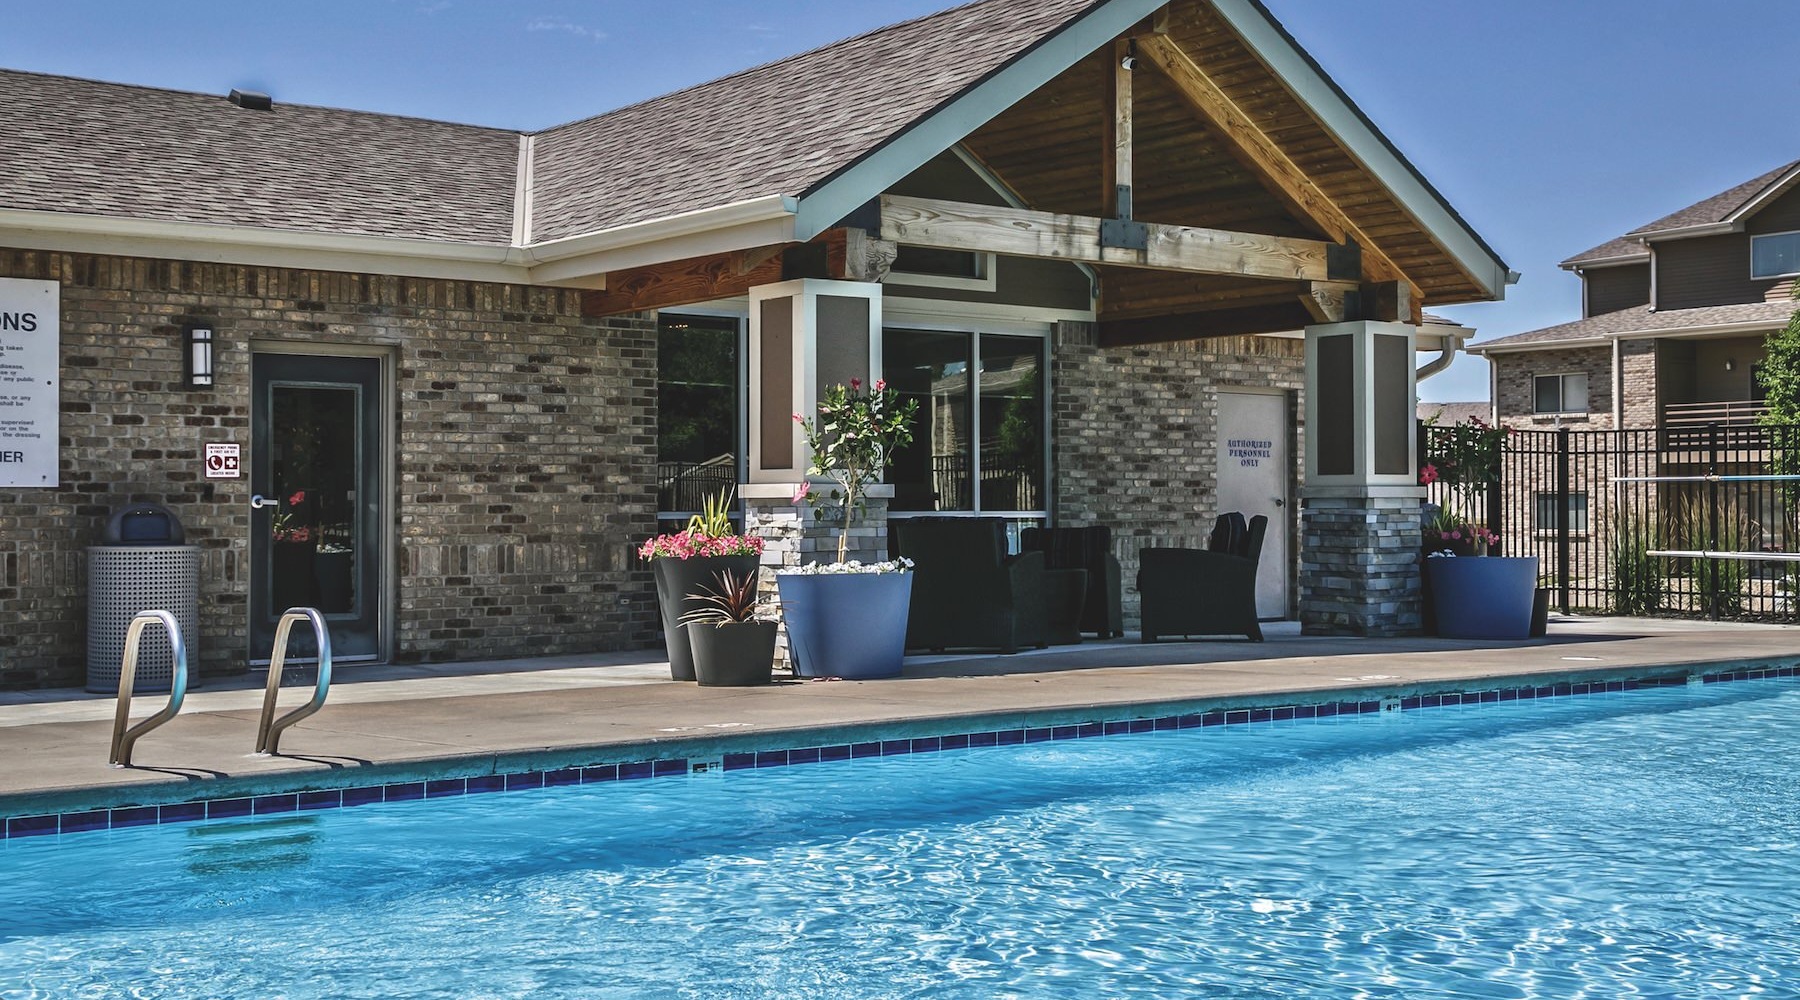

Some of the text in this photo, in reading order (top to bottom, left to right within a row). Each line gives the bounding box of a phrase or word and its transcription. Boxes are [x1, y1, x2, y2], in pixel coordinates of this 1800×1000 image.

[0, 312, 37, 332] NS
[1228, 439, 1272, 449] AUTHORIZED
[1229, 449, 1271, 458] PERSONNEL
[1240, 459, 1259, 467] ONLY
